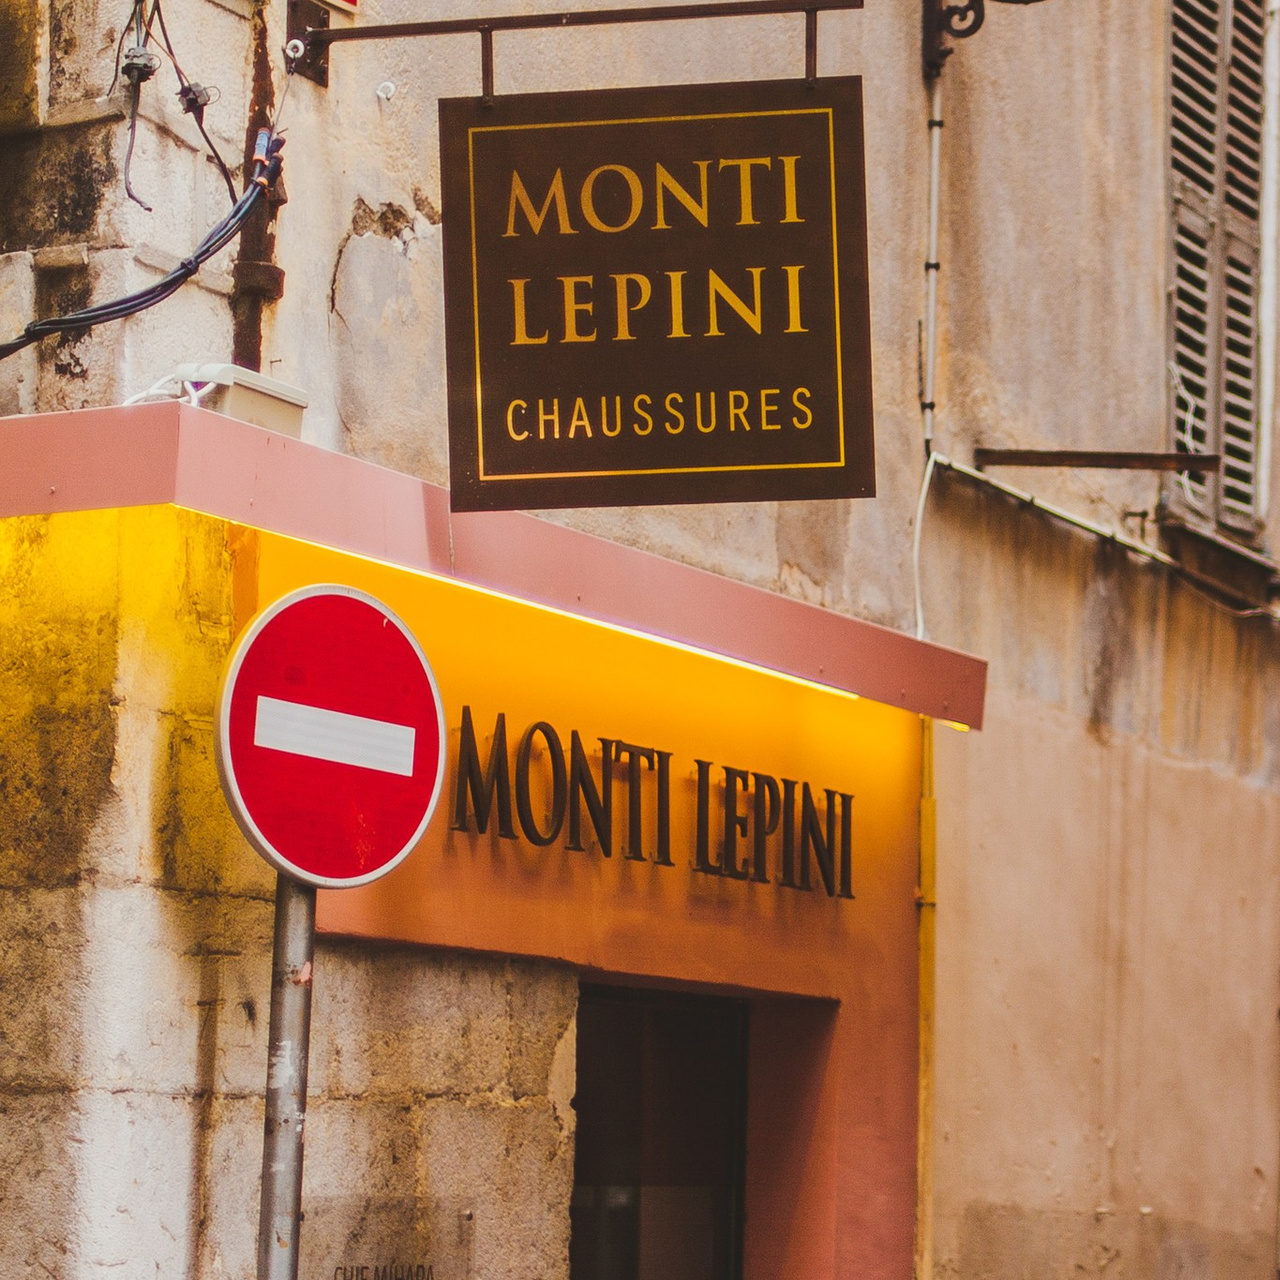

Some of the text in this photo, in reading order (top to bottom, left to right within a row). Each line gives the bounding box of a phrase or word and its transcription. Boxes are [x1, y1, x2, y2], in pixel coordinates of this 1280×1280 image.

[501, 155, 806, 238] MONTI
[507, 265, 809, 346] LEPINI
[506, 387, 813, 441] CHAUSSURES
[450, 705, 855, 900] MONTI LEPINI
